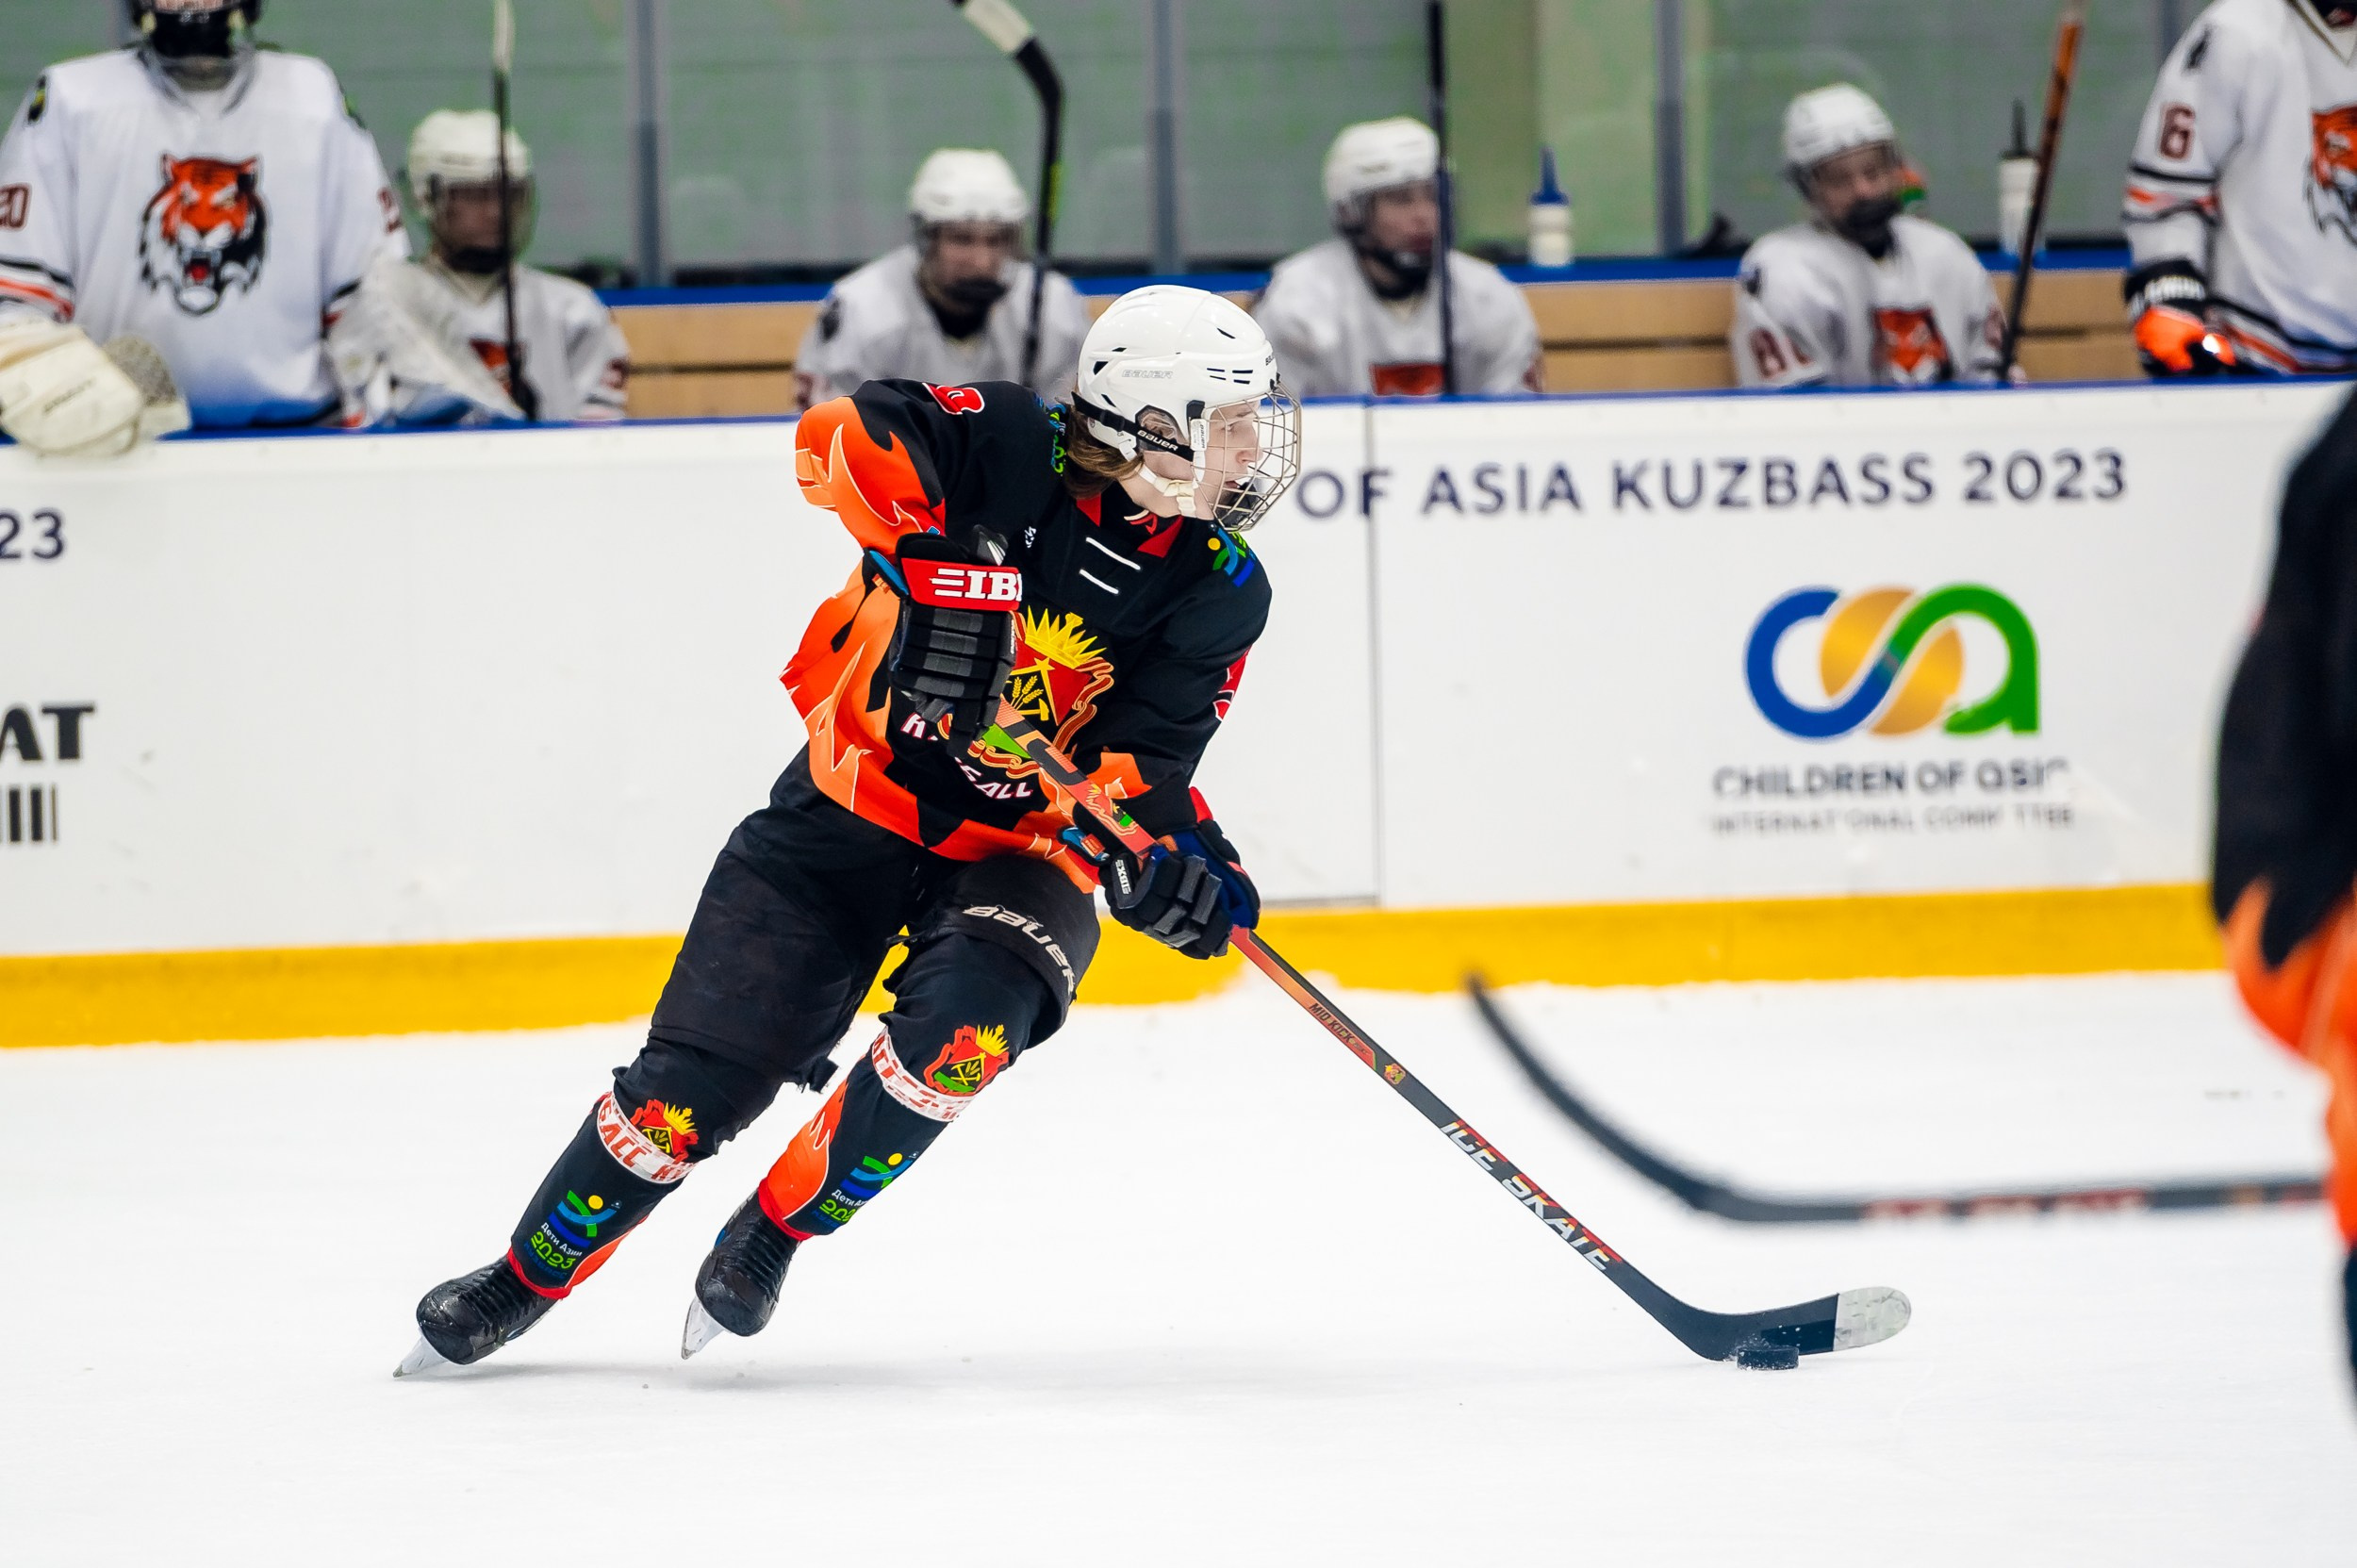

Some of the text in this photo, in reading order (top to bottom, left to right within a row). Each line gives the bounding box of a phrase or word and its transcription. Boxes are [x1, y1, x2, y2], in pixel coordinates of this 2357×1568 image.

[2158, 103, 2195, 162] 6
[1136, 429, 1179, 452] BAUER
[1296, 451, 2126, 520] OF ASIA KUZBASS 2023
[1712, 763, 1905, 799] CHILDREN
[1915, 758, 1963, 795] OF
[1440, 1121, 1611, 1271] ICE SKATE
[531, 1230, 576, 1270] 2023
[540, 1222, 560, 1246] Дети
